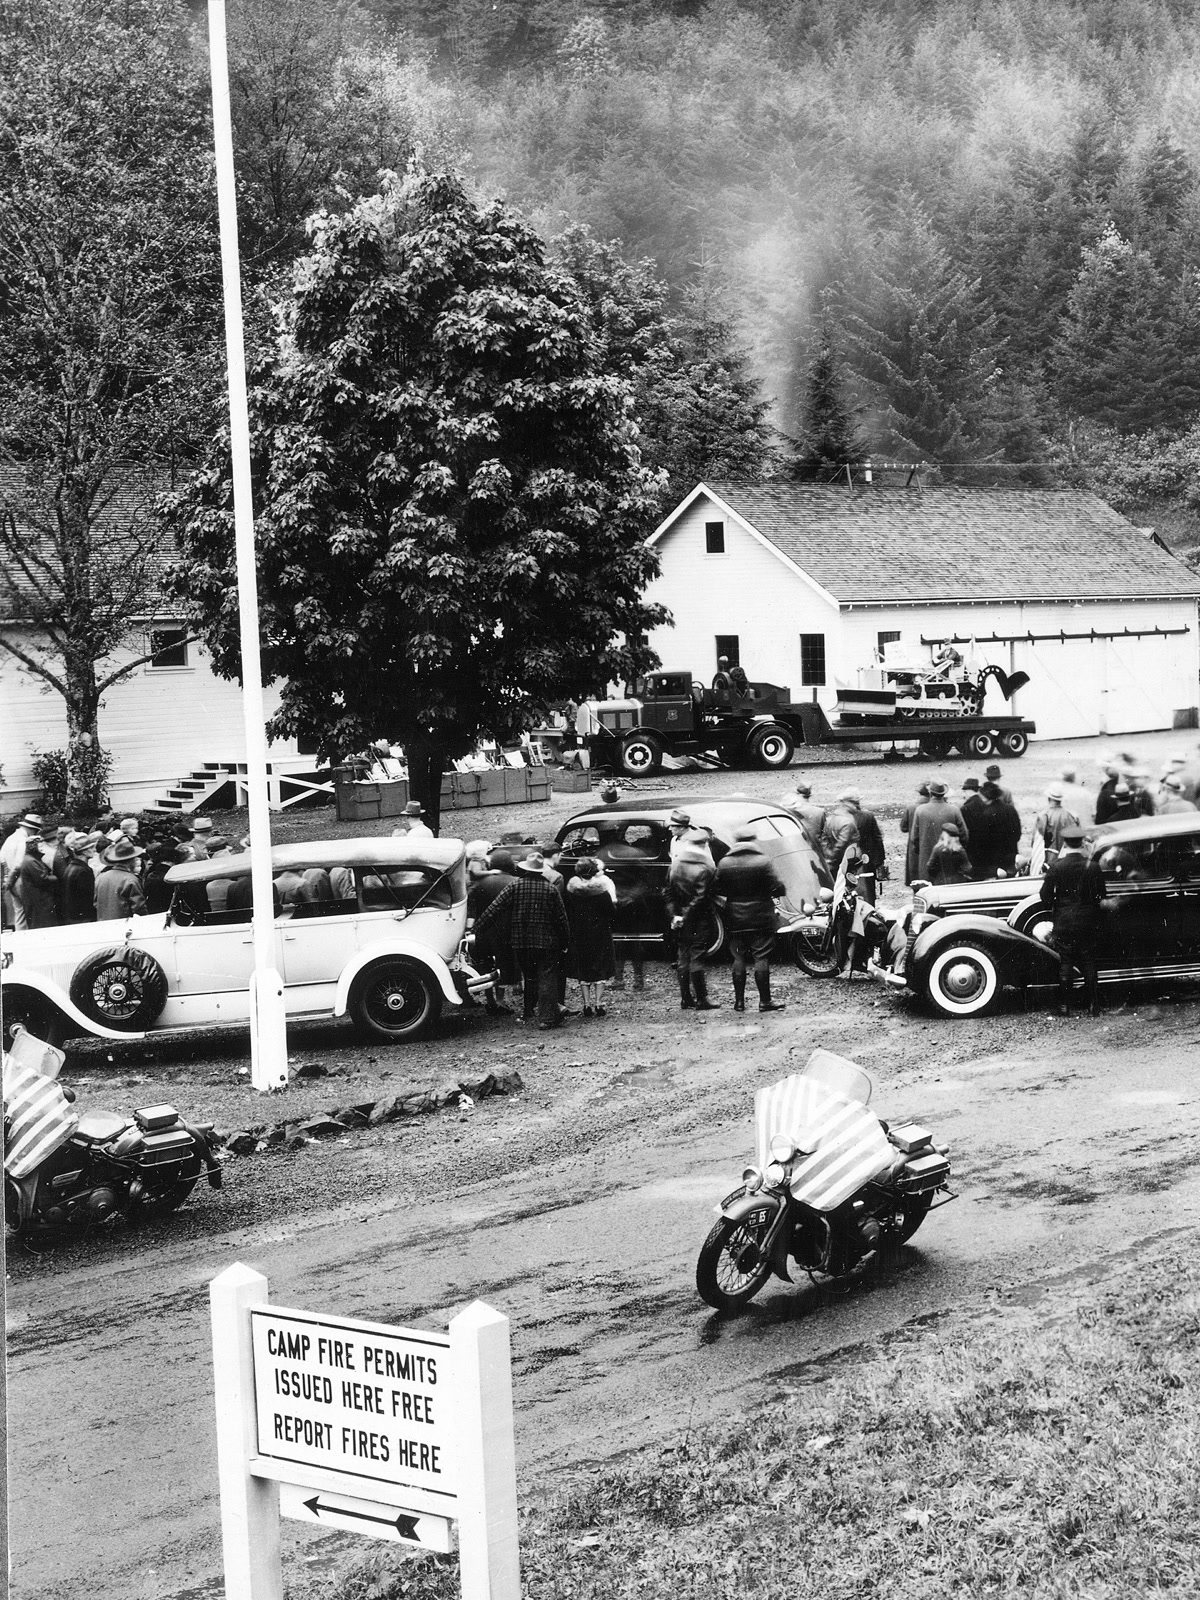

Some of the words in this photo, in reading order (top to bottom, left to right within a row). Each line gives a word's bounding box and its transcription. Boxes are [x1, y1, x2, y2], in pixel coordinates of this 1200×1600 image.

[268, 1329, 310, 1361] CAMP
[319, 1338, 355, 1370] FIRE
[364, 1346, 437, 1385] PERMITS
[275, 1369, 332, 1404] ISSUED
[342, 1381, 384, 1414] HERE
[392, 1390, 434, 1424] FREE
[274, 1413, 332, 1450] REPORT
[343, 1427, 389, 1461] FIRES
[399, 1439, 441, 1473] HERE
